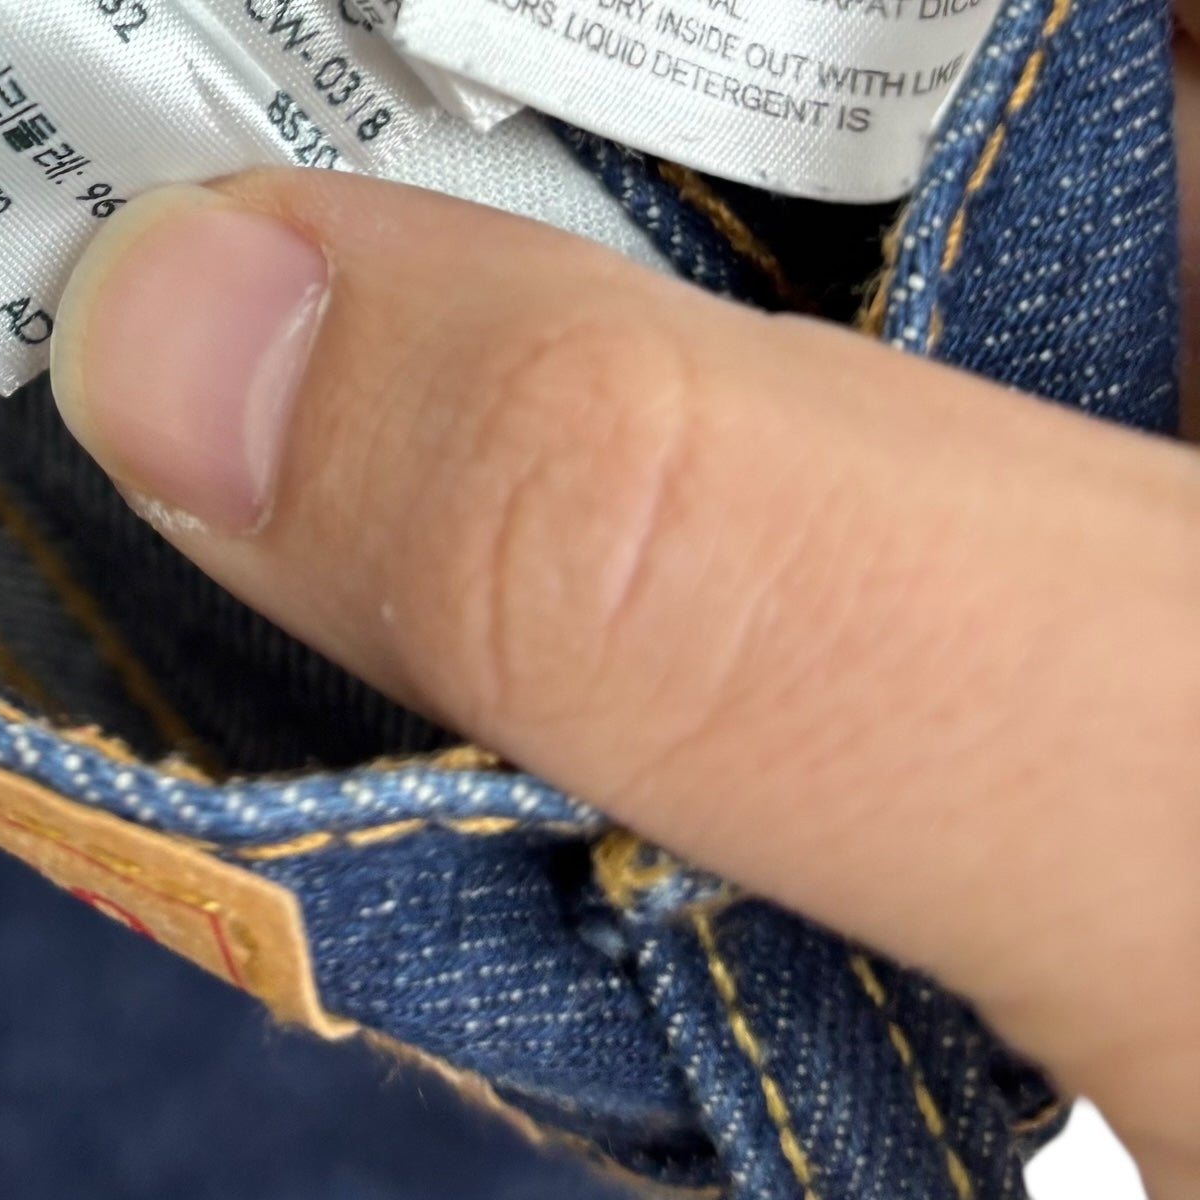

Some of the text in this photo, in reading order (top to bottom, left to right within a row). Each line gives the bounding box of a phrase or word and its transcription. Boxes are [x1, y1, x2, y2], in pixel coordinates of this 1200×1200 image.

[564, 11, 647, 69] LIQUID
[651, 49, 830, 126] DETERGENT
[836, 107, 872, 133] IS
[655, 6, 740, 61] INSIDE
[745, 42, 808, 83] OUT
[818, 60, 905, 98] WITH
